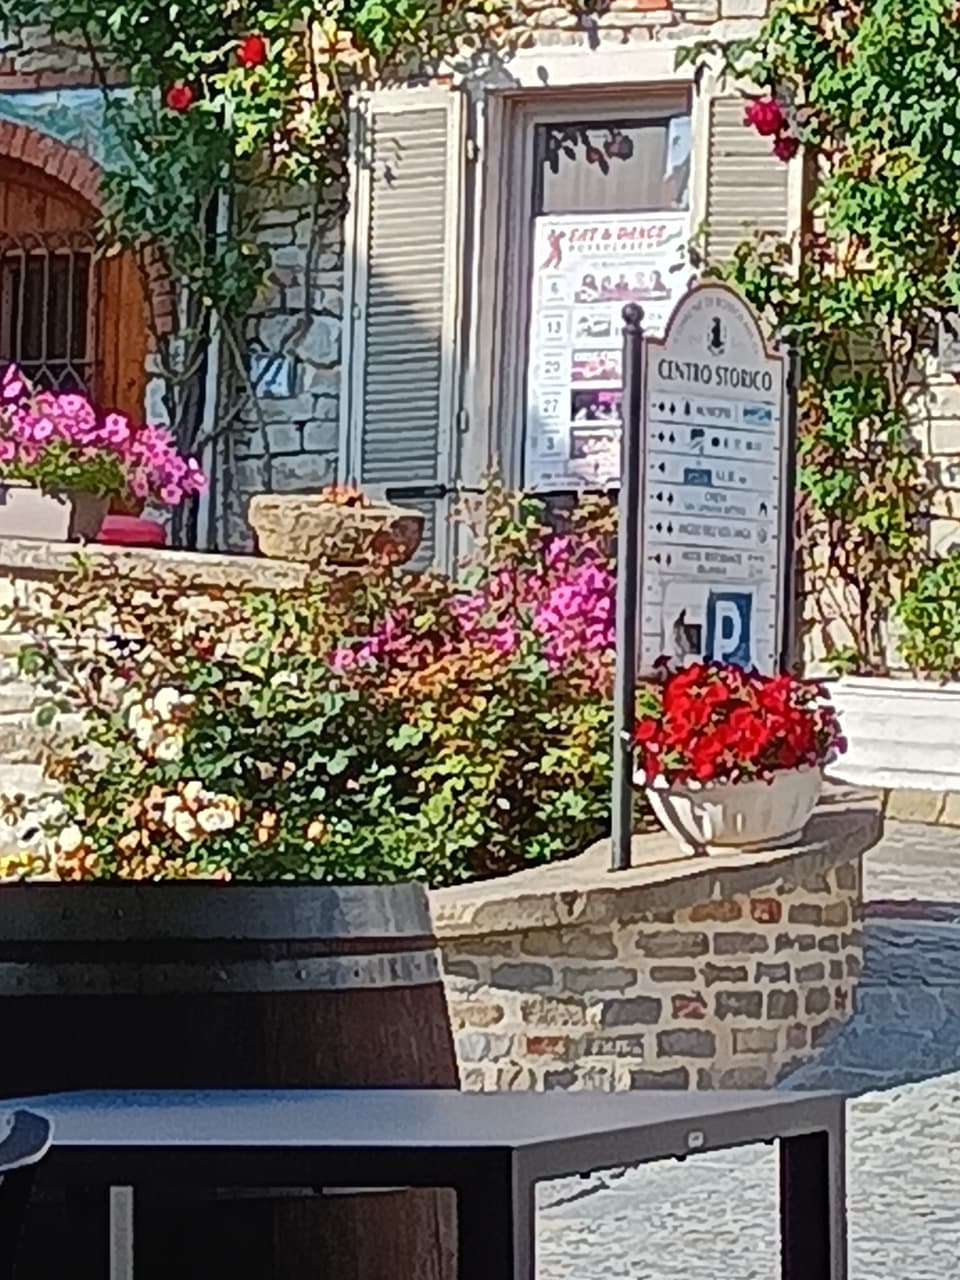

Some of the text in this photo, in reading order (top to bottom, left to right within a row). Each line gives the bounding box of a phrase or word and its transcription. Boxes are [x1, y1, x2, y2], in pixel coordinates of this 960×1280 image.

[658, 358, 773, 392] CENTRO STORICO
[713, 600, 742, 665] P
